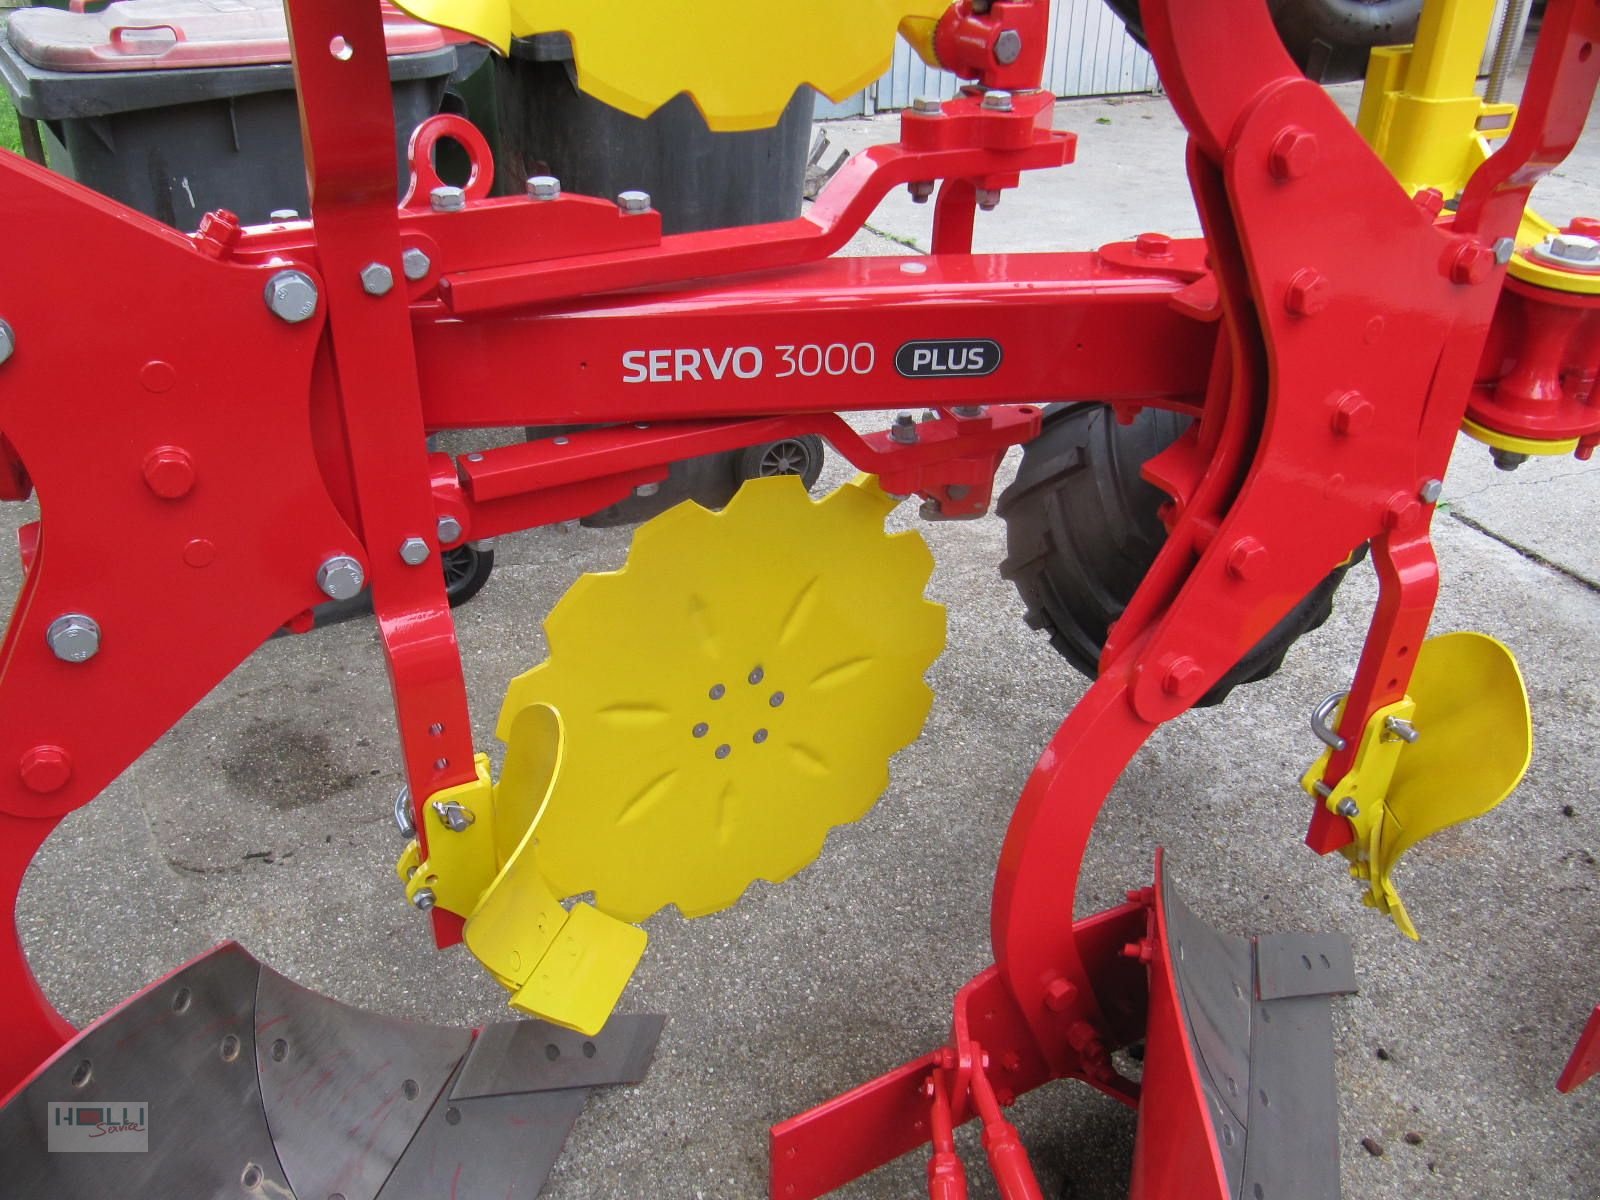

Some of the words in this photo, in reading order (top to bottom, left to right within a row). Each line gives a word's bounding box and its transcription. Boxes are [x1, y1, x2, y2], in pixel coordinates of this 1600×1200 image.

[622, 346, 763, 383] SERVO
[774, 342, 875, 378] 3000
[912, 347, 985, 372] PLUS
